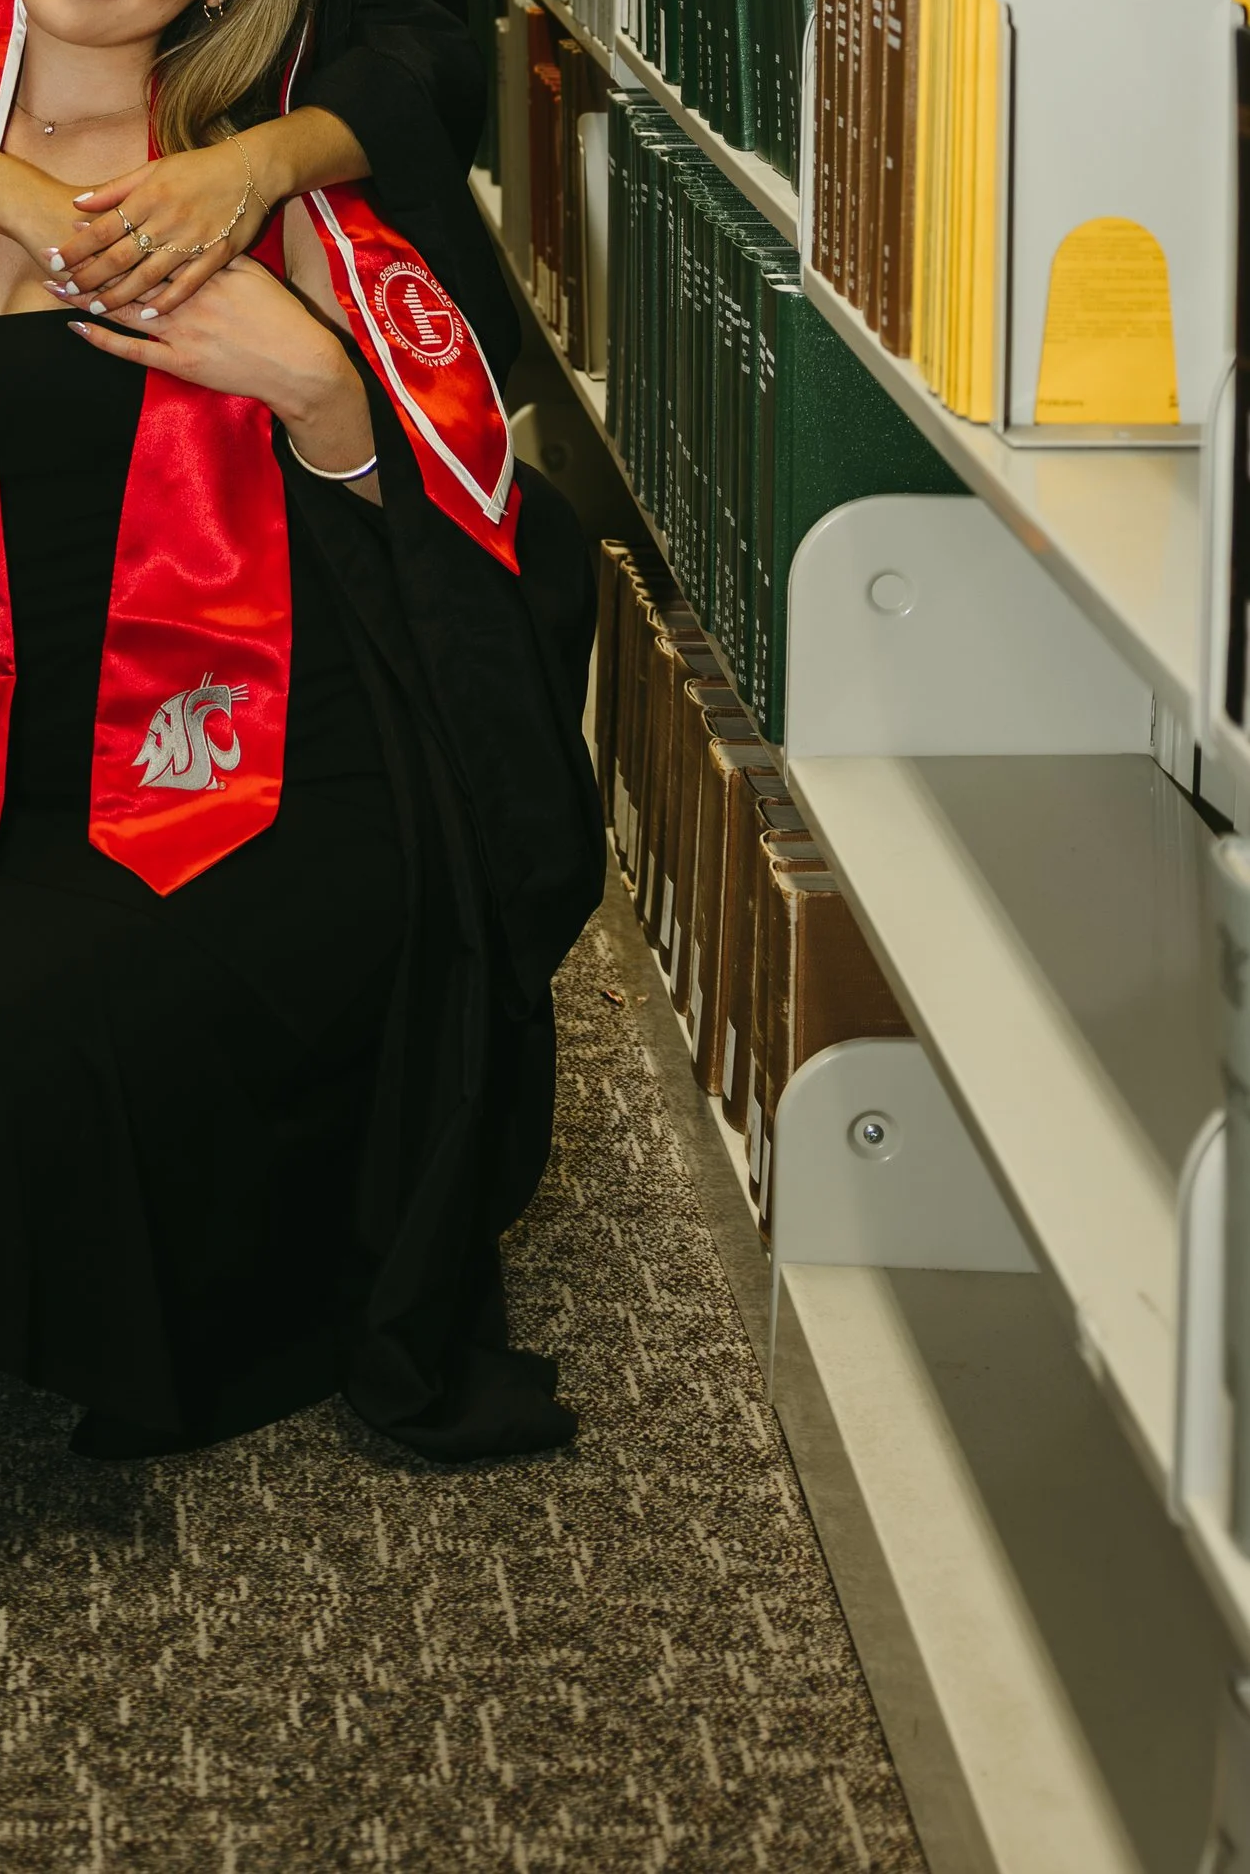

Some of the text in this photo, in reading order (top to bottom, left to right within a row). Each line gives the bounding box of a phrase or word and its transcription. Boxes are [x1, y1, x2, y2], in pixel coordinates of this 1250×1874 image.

[373, 261, 453, 312] FIRST GENERATION GRAD
[383, 317, 464, 367] FIRST GENERATION GRAD
